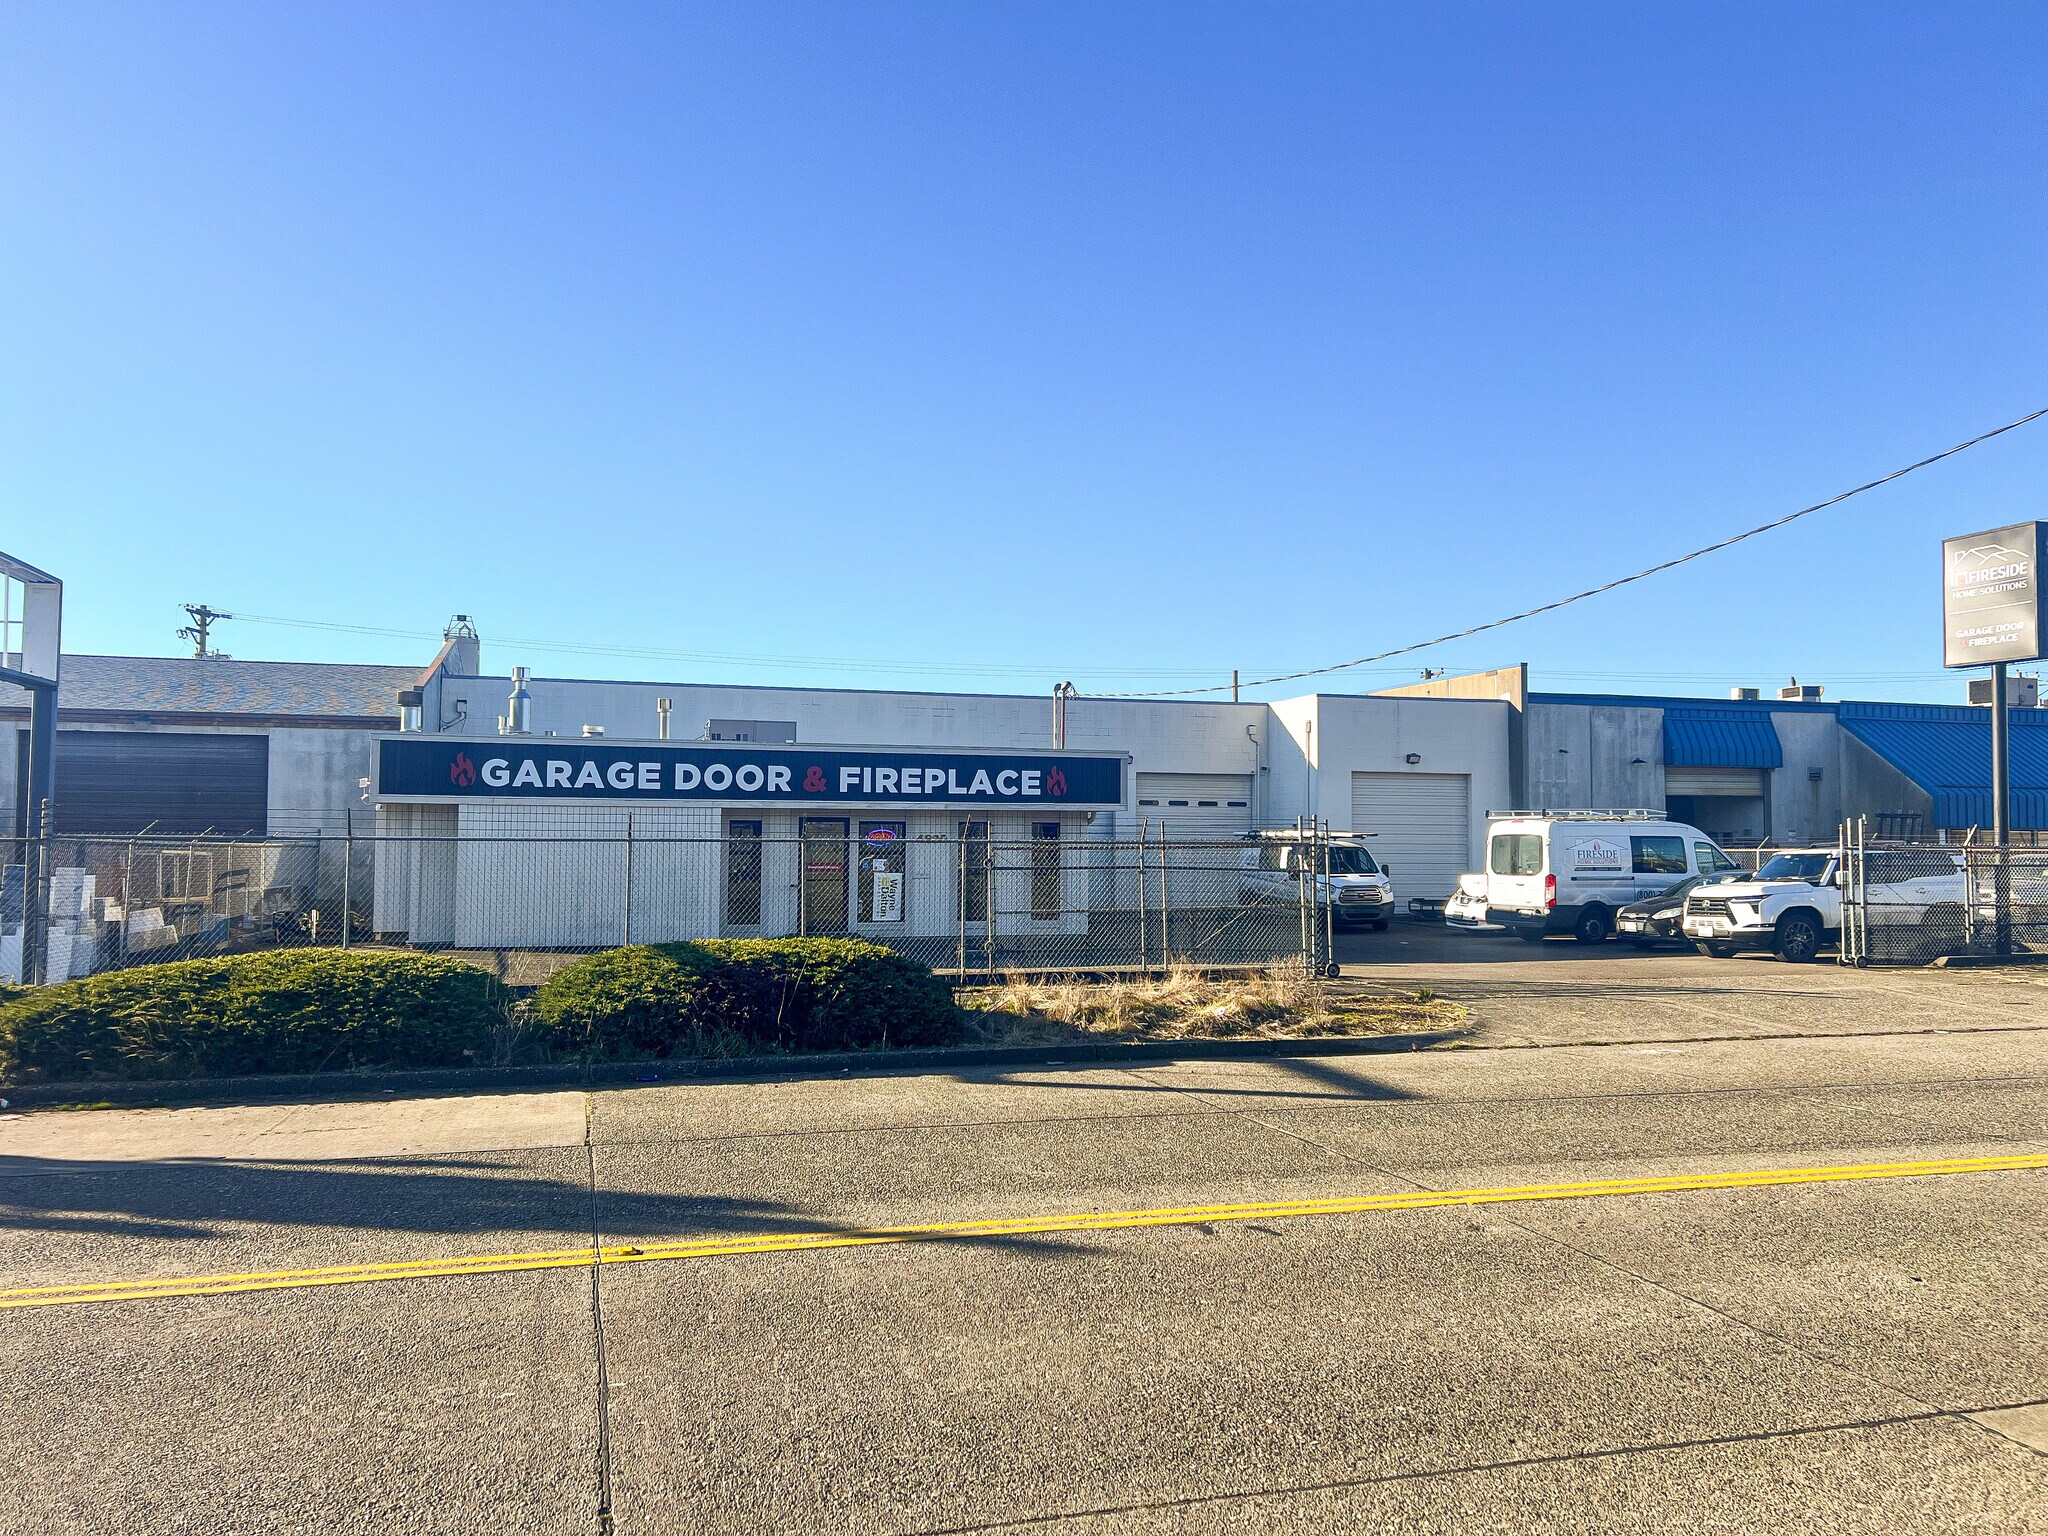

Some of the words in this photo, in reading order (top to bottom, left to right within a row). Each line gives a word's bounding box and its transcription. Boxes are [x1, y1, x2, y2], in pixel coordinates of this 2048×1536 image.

[1969, 561, 2028, 583] FIRESIDE
[1953, 589, 1977, 599] HOME
[1980, 580, 2028, 595] SOLUTIONS
[1956, 625, 1993, 638] GARAGE
[1996, 621, 2024, 633] DOOR
[1969, 633, 2018, 647] FIREPLACE
[481, 758, 661, 790] GARAGE
[674, 763, 792, 792] DOOR
[803, 765, 827, 793] &
[839, 766, 1042, 796] FIREPLACE
[1577, 850, 1618, 859] FIRESIDE
[880, 886, 889, 918] Dalton
[889, 879, 898, 911] Wayne
